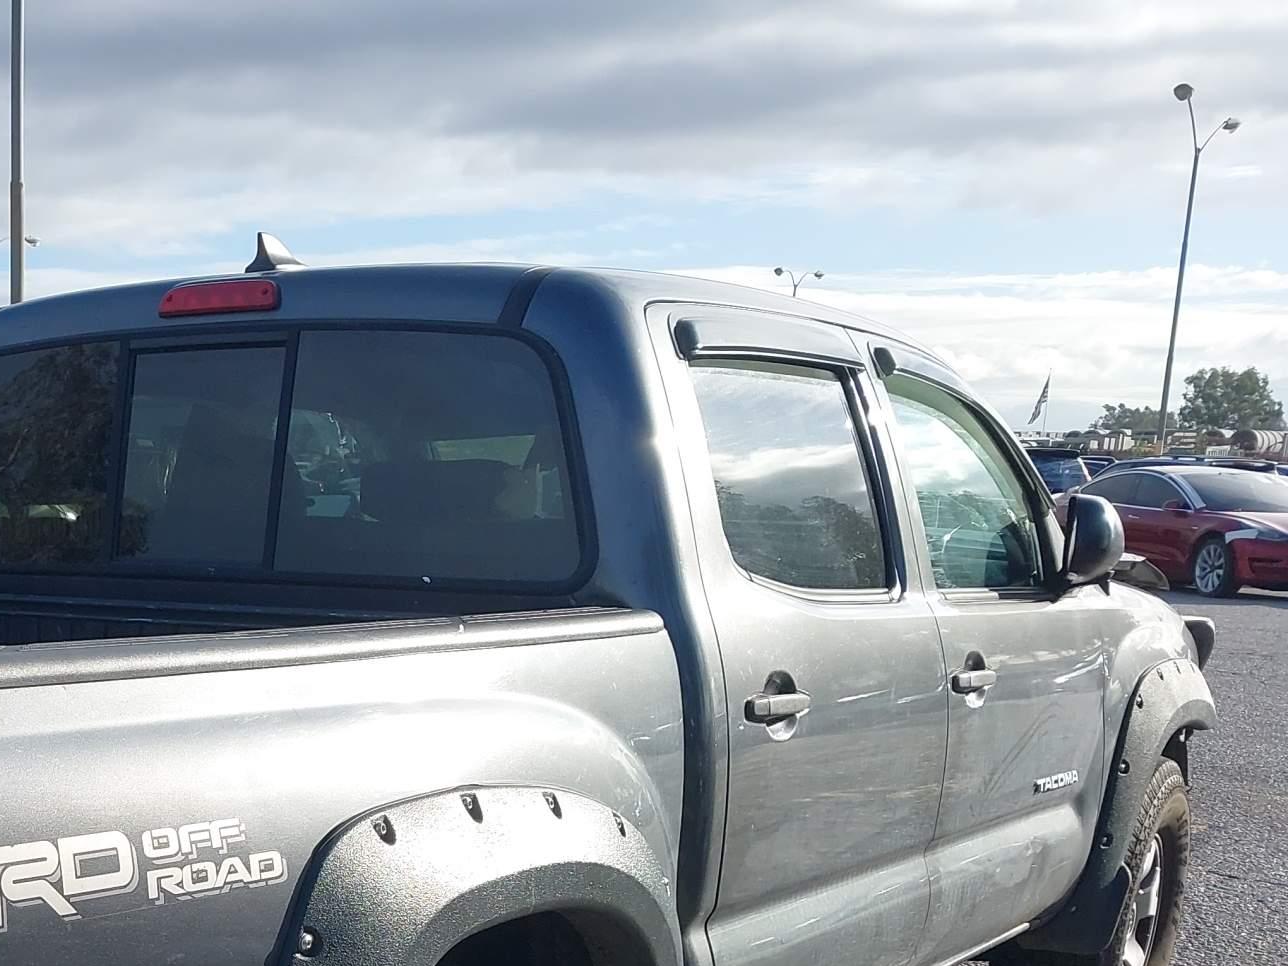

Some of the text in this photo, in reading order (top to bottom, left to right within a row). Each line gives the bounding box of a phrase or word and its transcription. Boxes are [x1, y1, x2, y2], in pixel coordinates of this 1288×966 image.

[1036, 769, 1079, 792] TACOMA
[142, 817, 246, 865] OFF
[145, 849, 289, 905] ROAD
